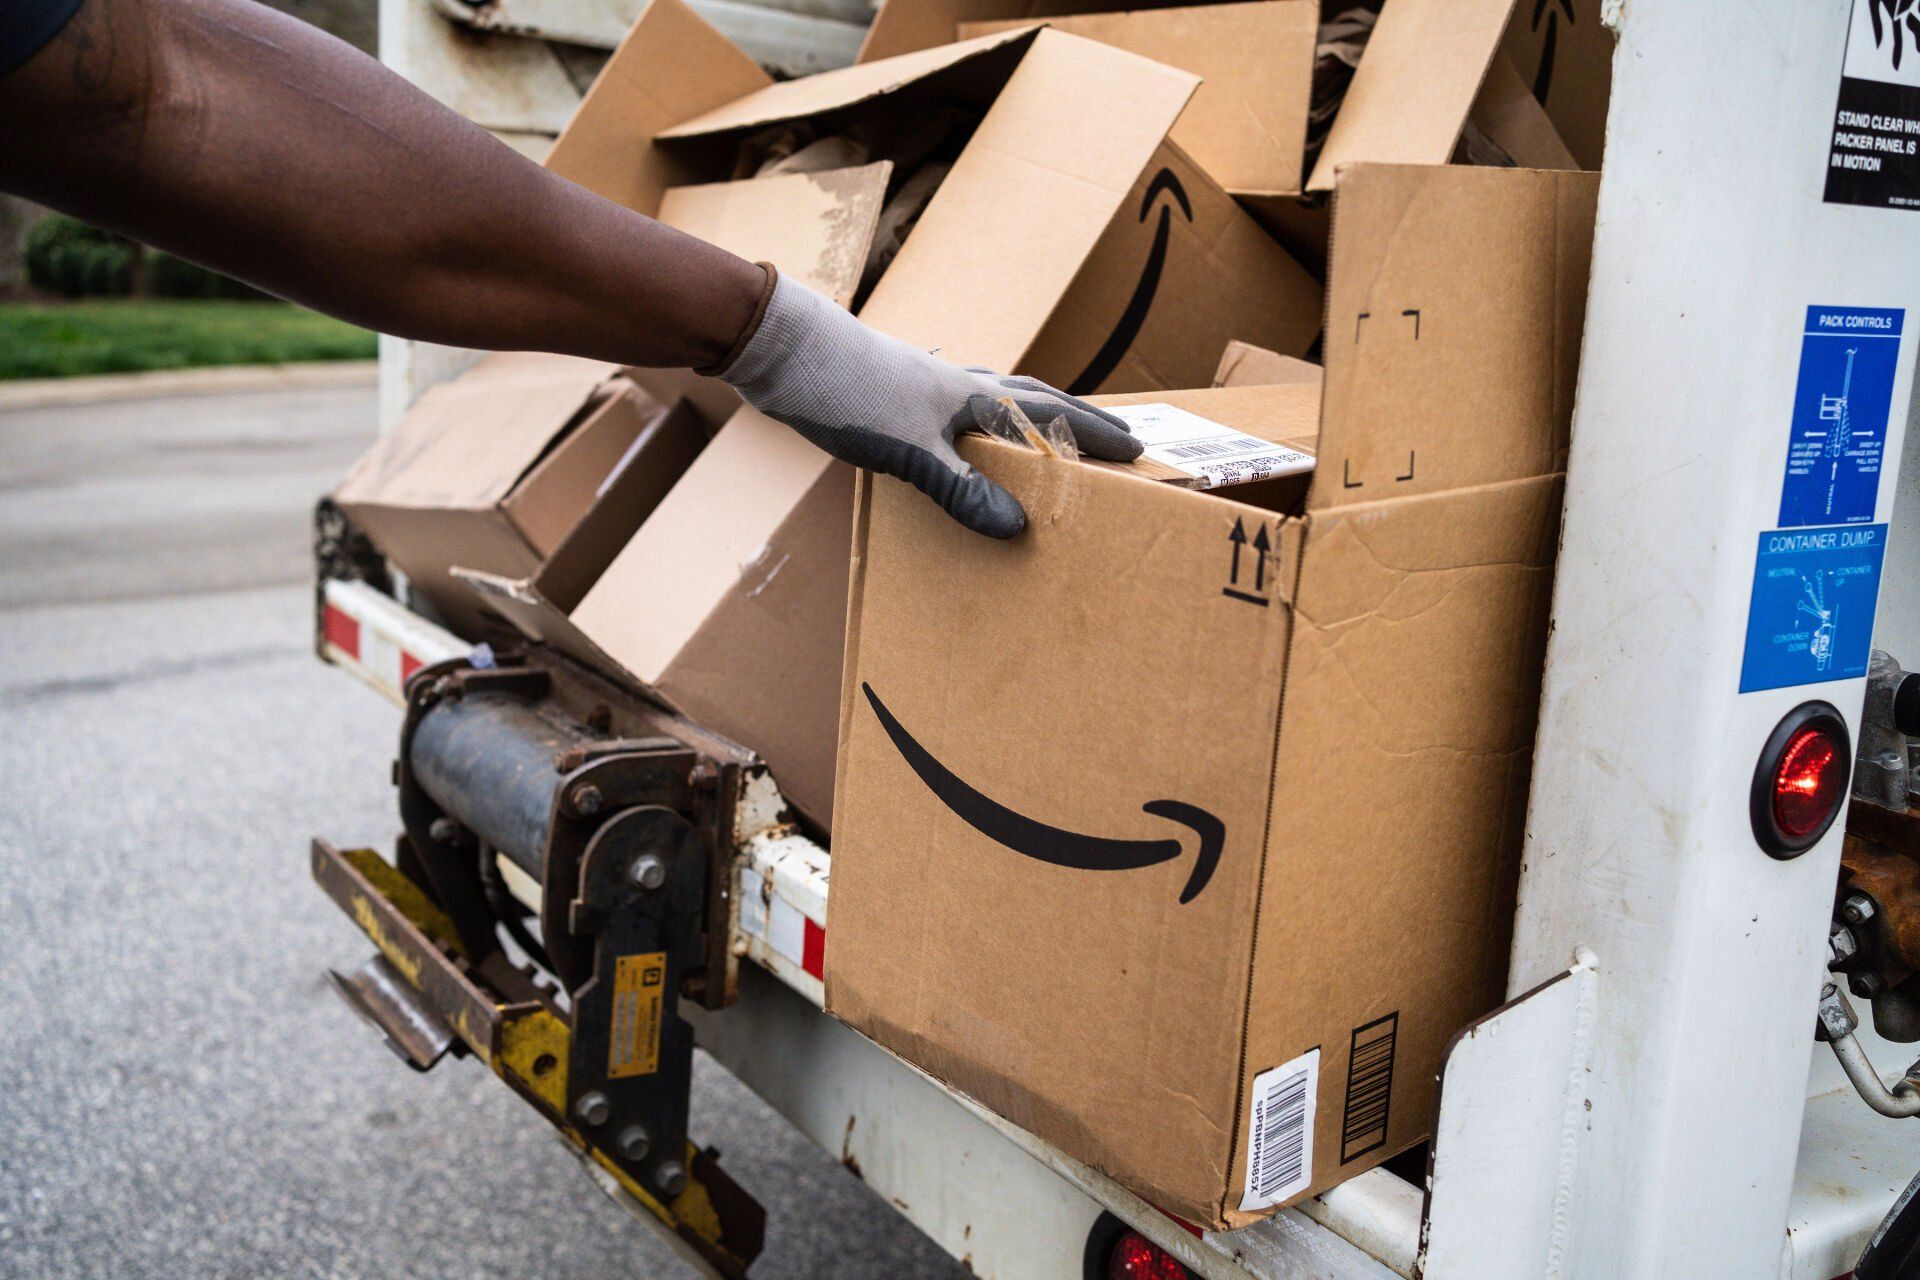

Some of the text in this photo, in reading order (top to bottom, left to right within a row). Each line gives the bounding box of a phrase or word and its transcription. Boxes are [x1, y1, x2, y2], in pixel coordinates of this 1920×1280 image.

[1837, 110, 1871, 127] STAND
[1871, 115, 1904, 132] CLEAR
[1834, 132, 1916, 155] PACKER PANEL IS
[1831, 152, 1881, 171] IN MOTION
[1819, 315, 1893, 329] PACK CONTROLS
[1768, 531, 1875, 553] CONTAINER DUMP
[1836, 565, 1872, 577] CONTAINER
[1773, 631, 1810, 644] CONTAINER
